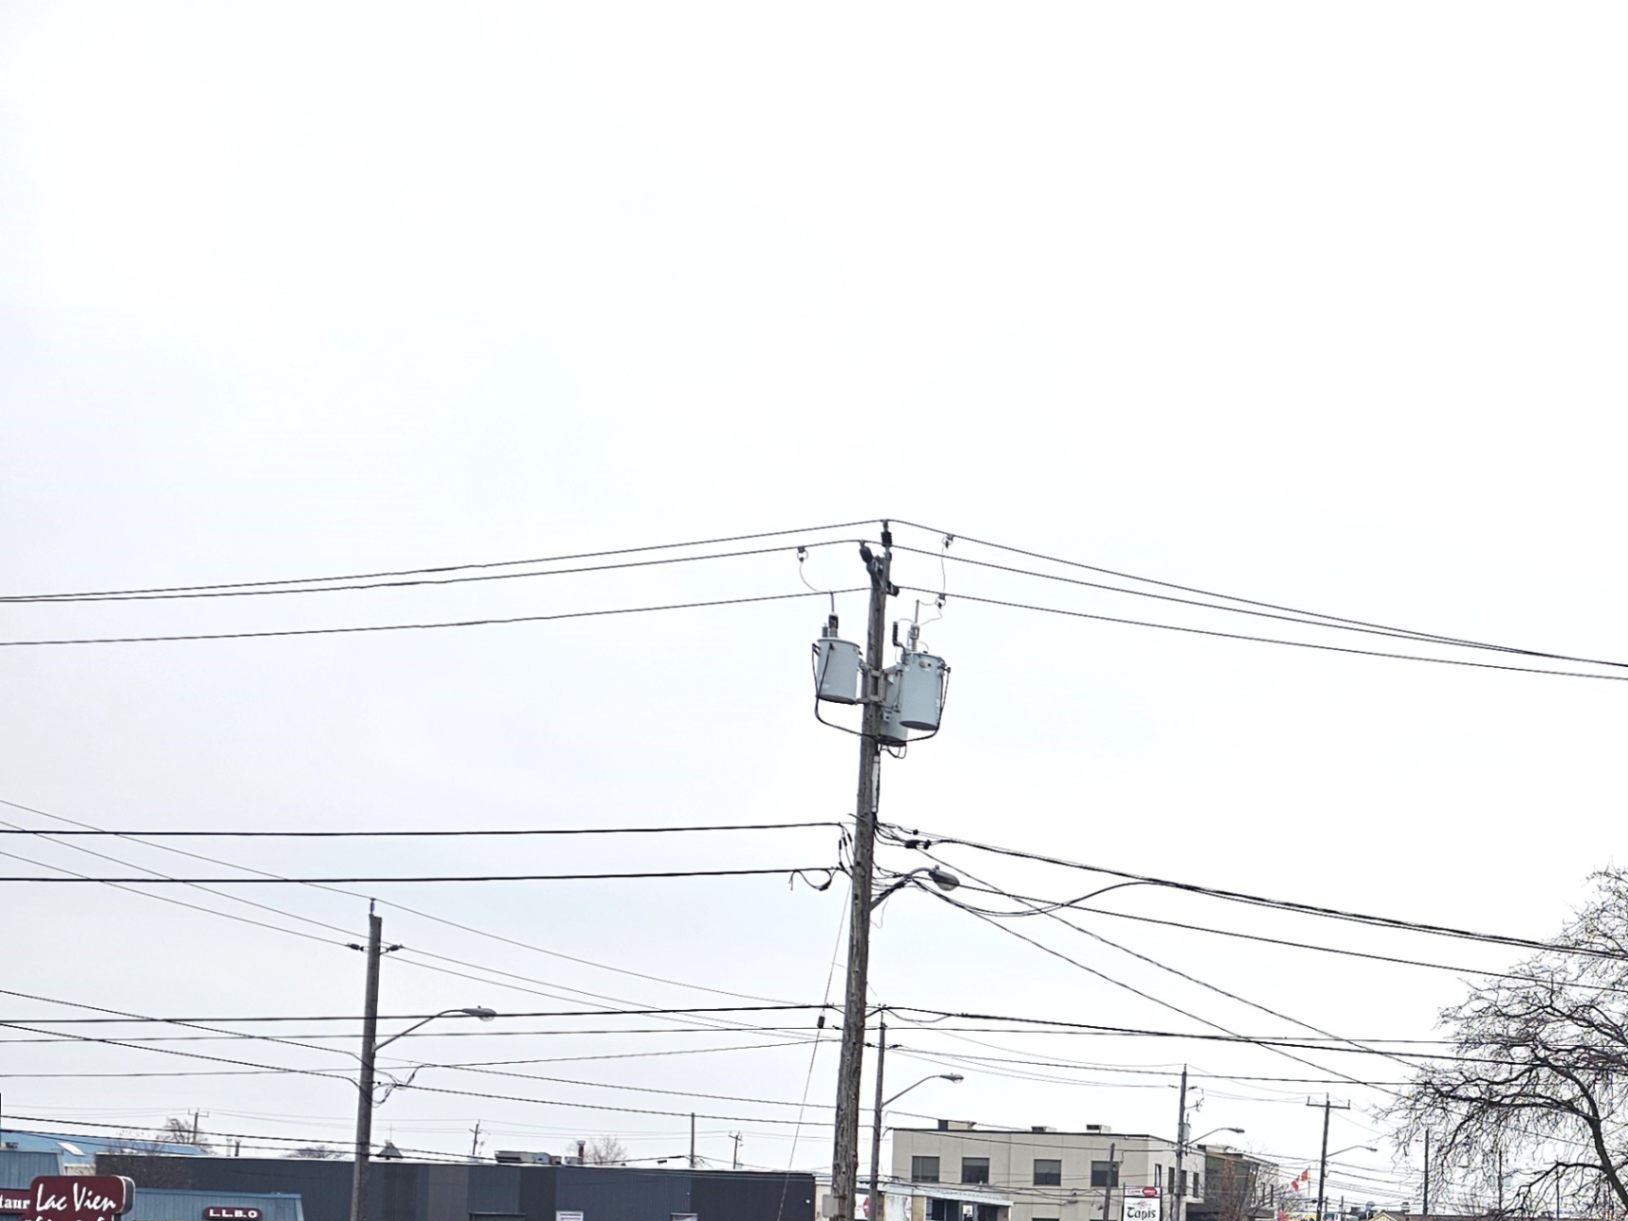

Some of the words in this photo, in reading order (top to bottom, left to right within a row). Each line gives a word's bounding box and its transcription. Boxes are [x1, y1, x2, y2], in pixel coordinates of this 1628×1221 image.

[35, 1183, 67, 1212] Lac
[73, 1182, 116, 1212] Vien
[1126, 1206, 1157, 1221] Tapis
